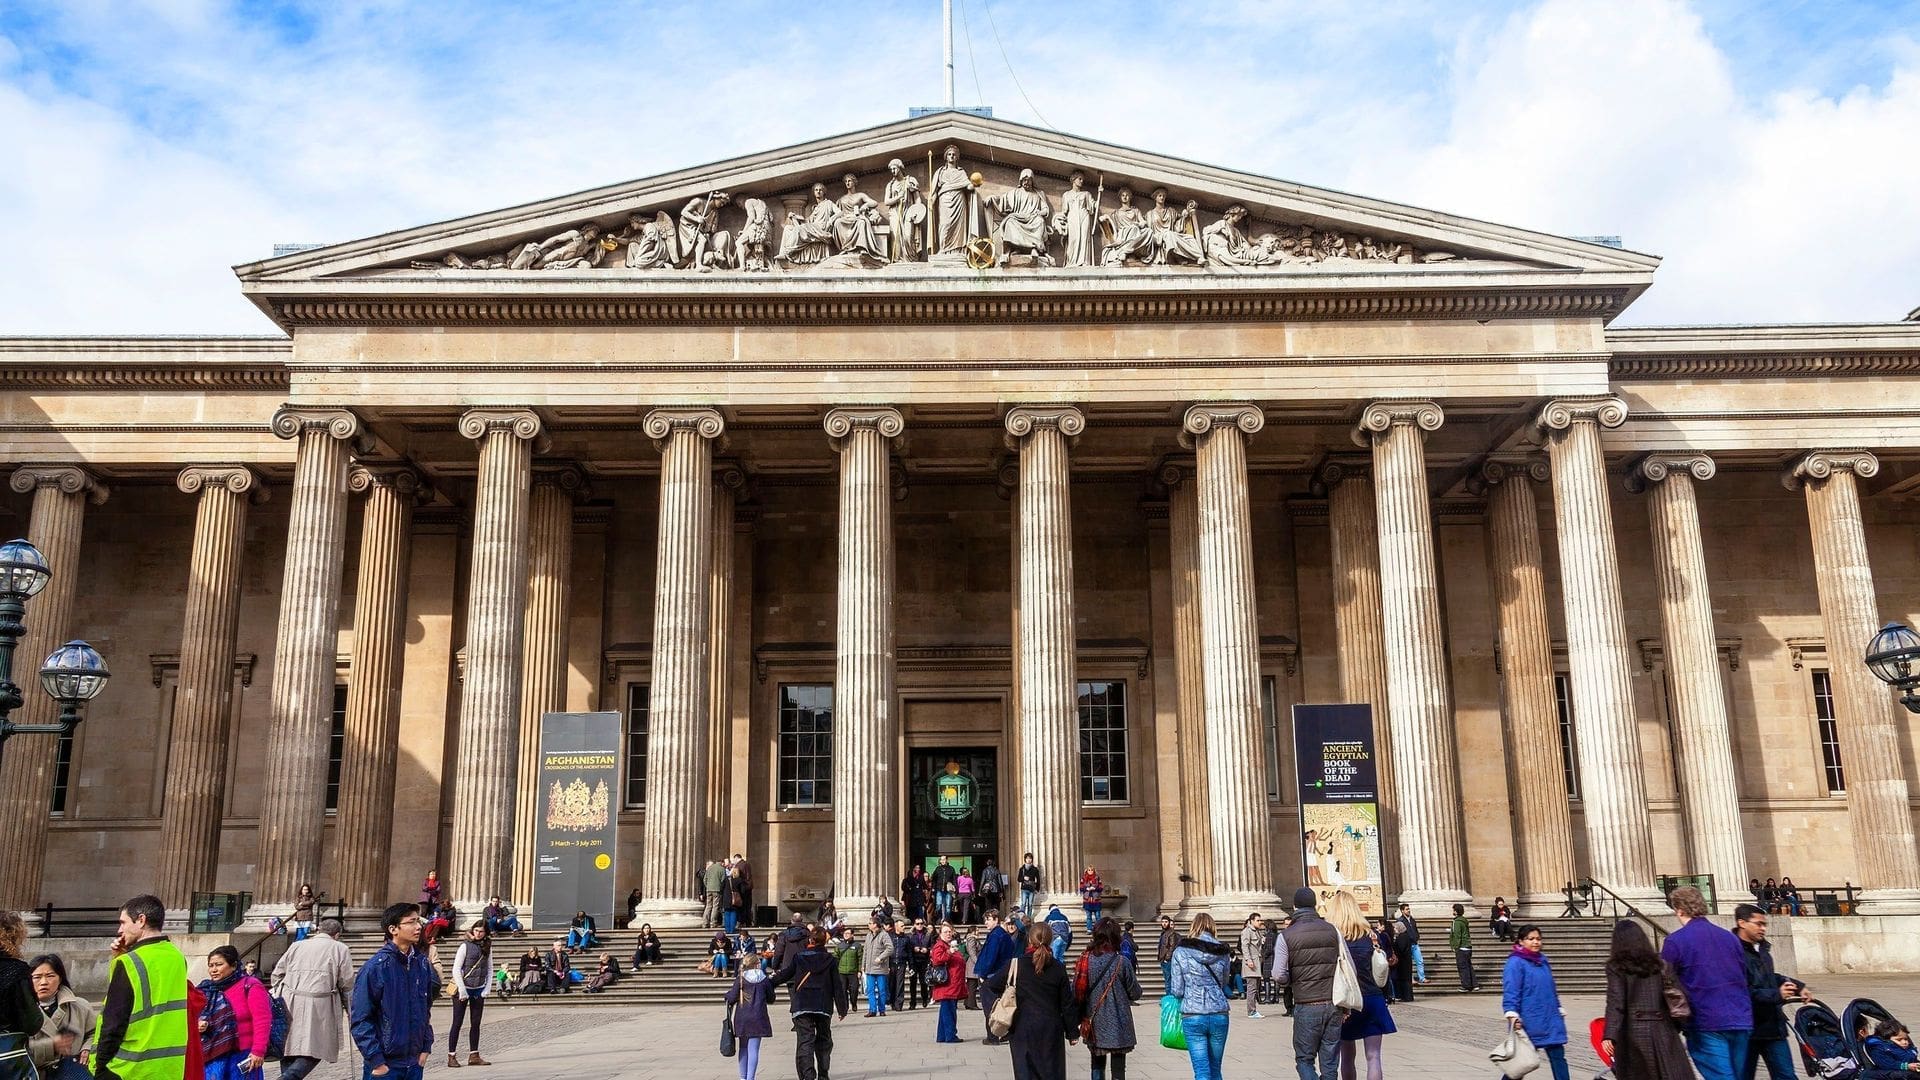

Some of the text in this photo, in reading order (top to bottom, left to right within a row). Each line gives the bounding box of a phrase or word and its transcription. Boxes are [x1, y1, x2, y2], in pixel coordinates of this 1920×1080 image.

[1323, 745, 1363, 753] ANCIENT
[545, 755, 615, 765] AFGHANISTAN
[1323, 752, 1369, 760] EGYPTIAN
[1325, 774, 1351, 782] DEAD
